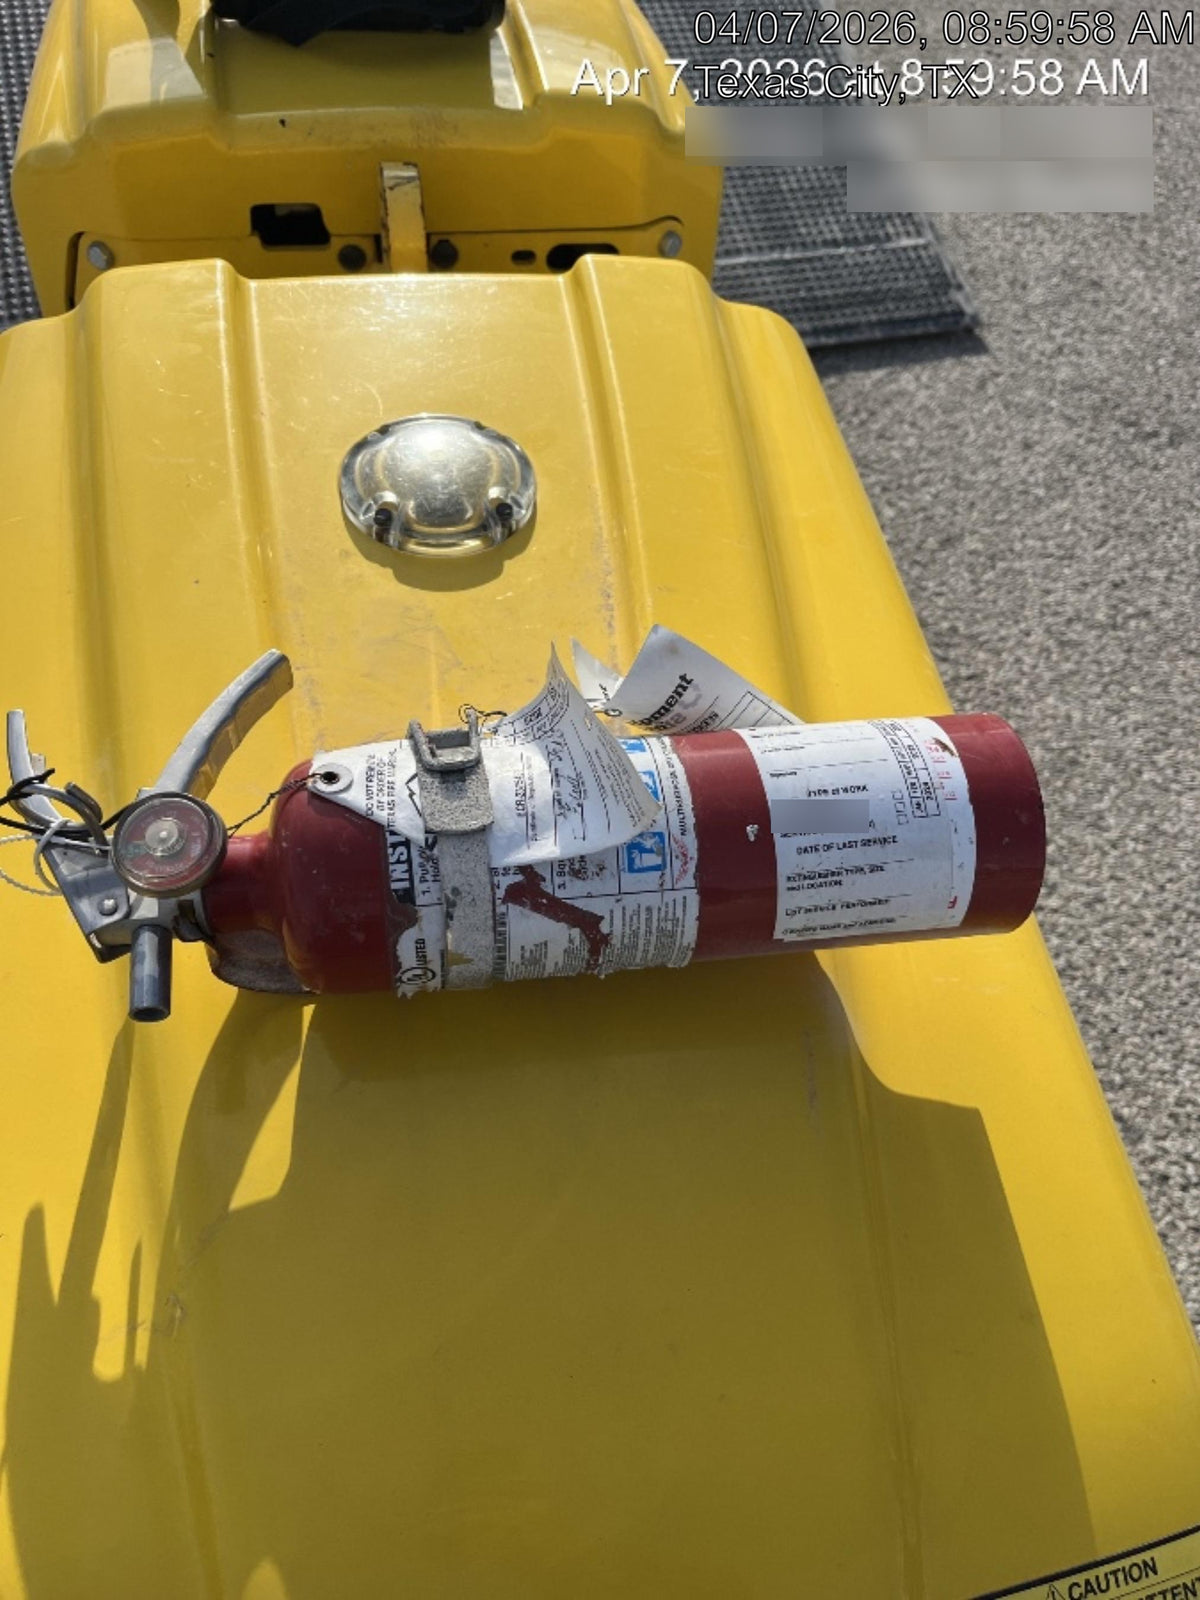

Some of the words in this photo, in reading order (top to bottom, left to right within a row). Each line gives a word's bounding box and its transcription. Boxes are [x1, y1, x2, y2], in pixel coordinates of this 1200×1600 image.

[796, 843, 821, 856] DATE
[822, 842, 835, 853] OF
[836, 840, 859, 851] LAST
[860, 835, 899, 848] SERVICE
[415, 938, 427, 966] LISTED
[1067, 1556, 1159, 1600] CAUTION
